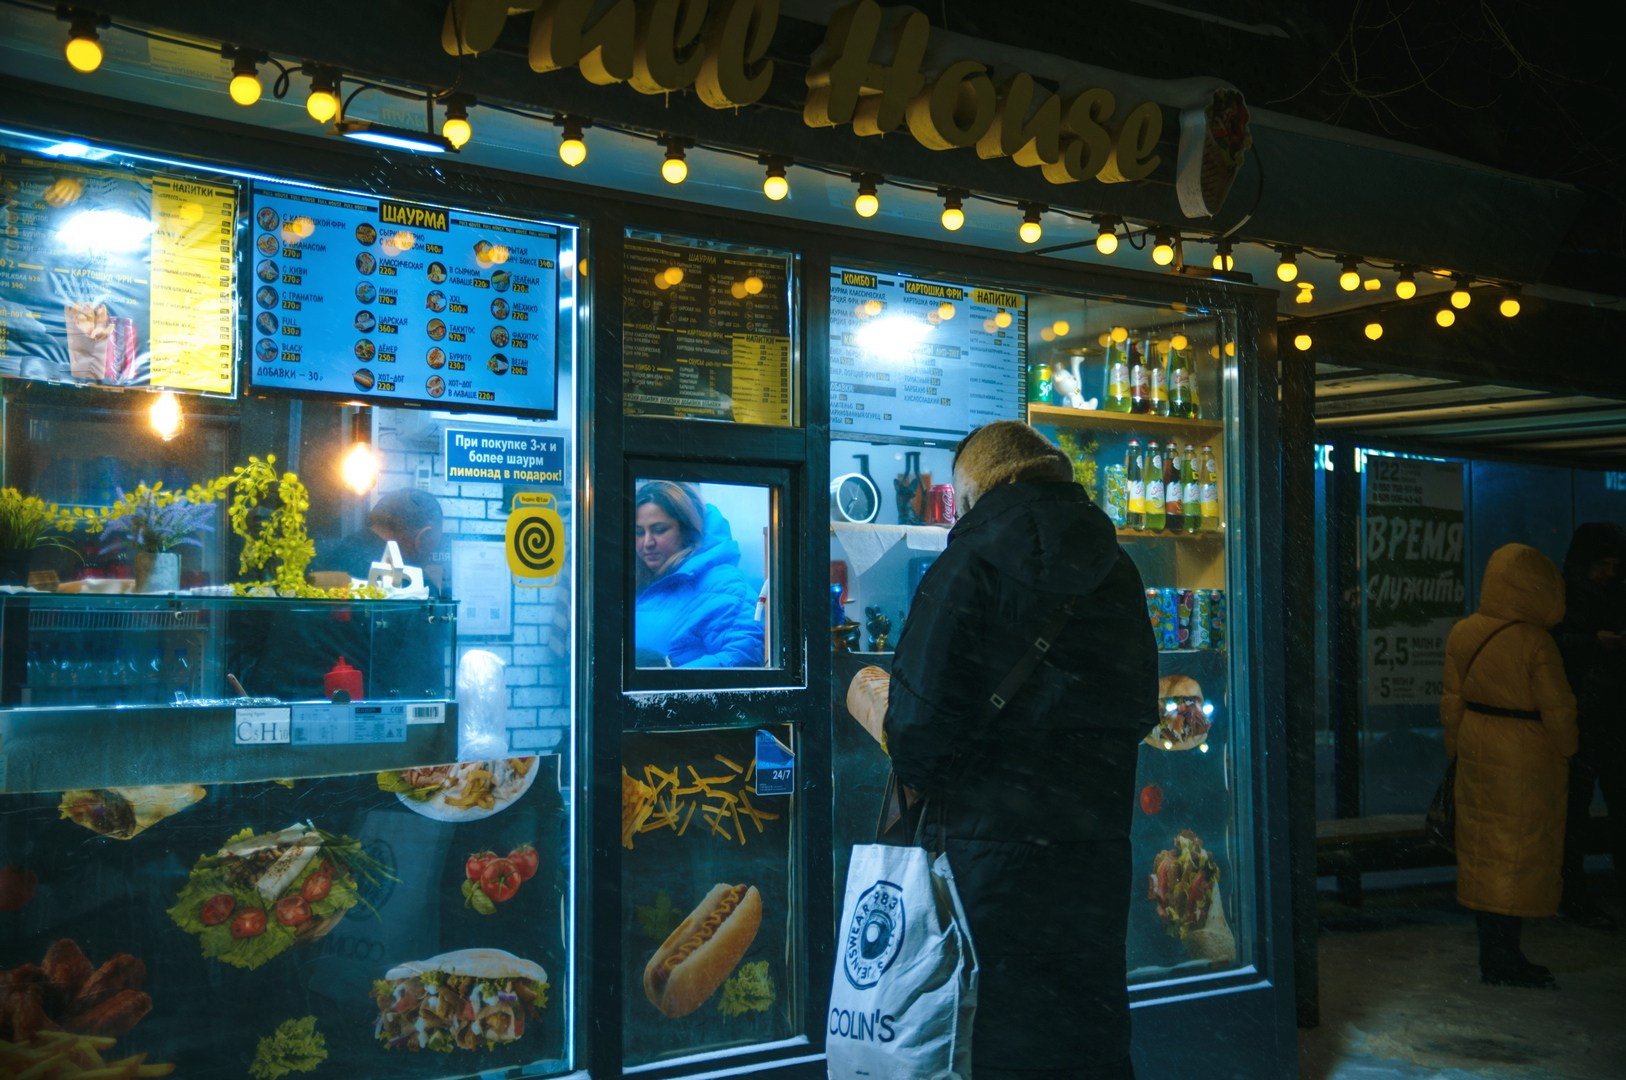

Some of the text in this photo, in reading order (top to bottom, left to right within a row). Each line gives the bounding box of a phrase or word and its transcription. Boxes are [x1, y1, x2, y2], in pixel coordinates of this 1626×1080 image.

[804, 0, 1163, 184] House
[172, 182, 213, 198] НАПИТКИ
[382, 204, 446, 231] ШАУРМА
[331, 220, 346, 230] ФРИ
[379, 258, 424, 271] КЛАССИЧЕСКАЯ
[519, 257, 537, 266] БОКСЕ
[688, 253, 717, 265] ШАУРМА
[289, 266, 308, 276] КИВИ
[454, 266, 480, 276] СЫРНОМ
[449, 276, 473, 287] ЛАВАШЕ
[844, 272, 876, 288] КОМБО 1
[379, 285, 398, 296] МИНИ
[906, 281, 963, 300] КАРТОШКА ФРИ
[289, 292, 324, 303] ГРАНАТОМ
[903, 296, 928, 306] КАРТОШКА
[977, 291, 1018, 309] НАПИТКИ
[513, 303, 538, 312] МЕХИКО
[282, 317, 297, 326] FULL
[378, 315, 408, 327] ЦАРСКАЯ
[449, 324, 476, 334] ТАКИТОС
[512, 331, 539, 341] ФАХИТОС
[746, 334, 775, 344] НАПИТКИ
[281, 342, 303, 353] BLACK
[449, 352, 472, 362] БУРИТО
[257, 367, 296, 379] ДОБАВКИ
[378, 373, 405, 384] ХОТ-ДОГ
[448, 380, 473, 389] ХОТ-ДОГ
[830, 382, 854, 393] ОБАВКИ
[453, 389, 477, 400] ЛАВАШЕ
[455, 434, 557, 453] При покупке 3-х и
[469, 450, 544, 468] более шаурм
[450, 466, 562, 483] лимонад в подарок!
[1372, 461, 1400, 482] 122
[1367, 515, 1464, 562] ВРЕМЯ
[1374, 636, 1409, 671] 2,5
[1380, 676, 1391, 699] 5
[772, 769, 791, 780] 24/7
[829, 1008, 896, 1043] COLIN'S
